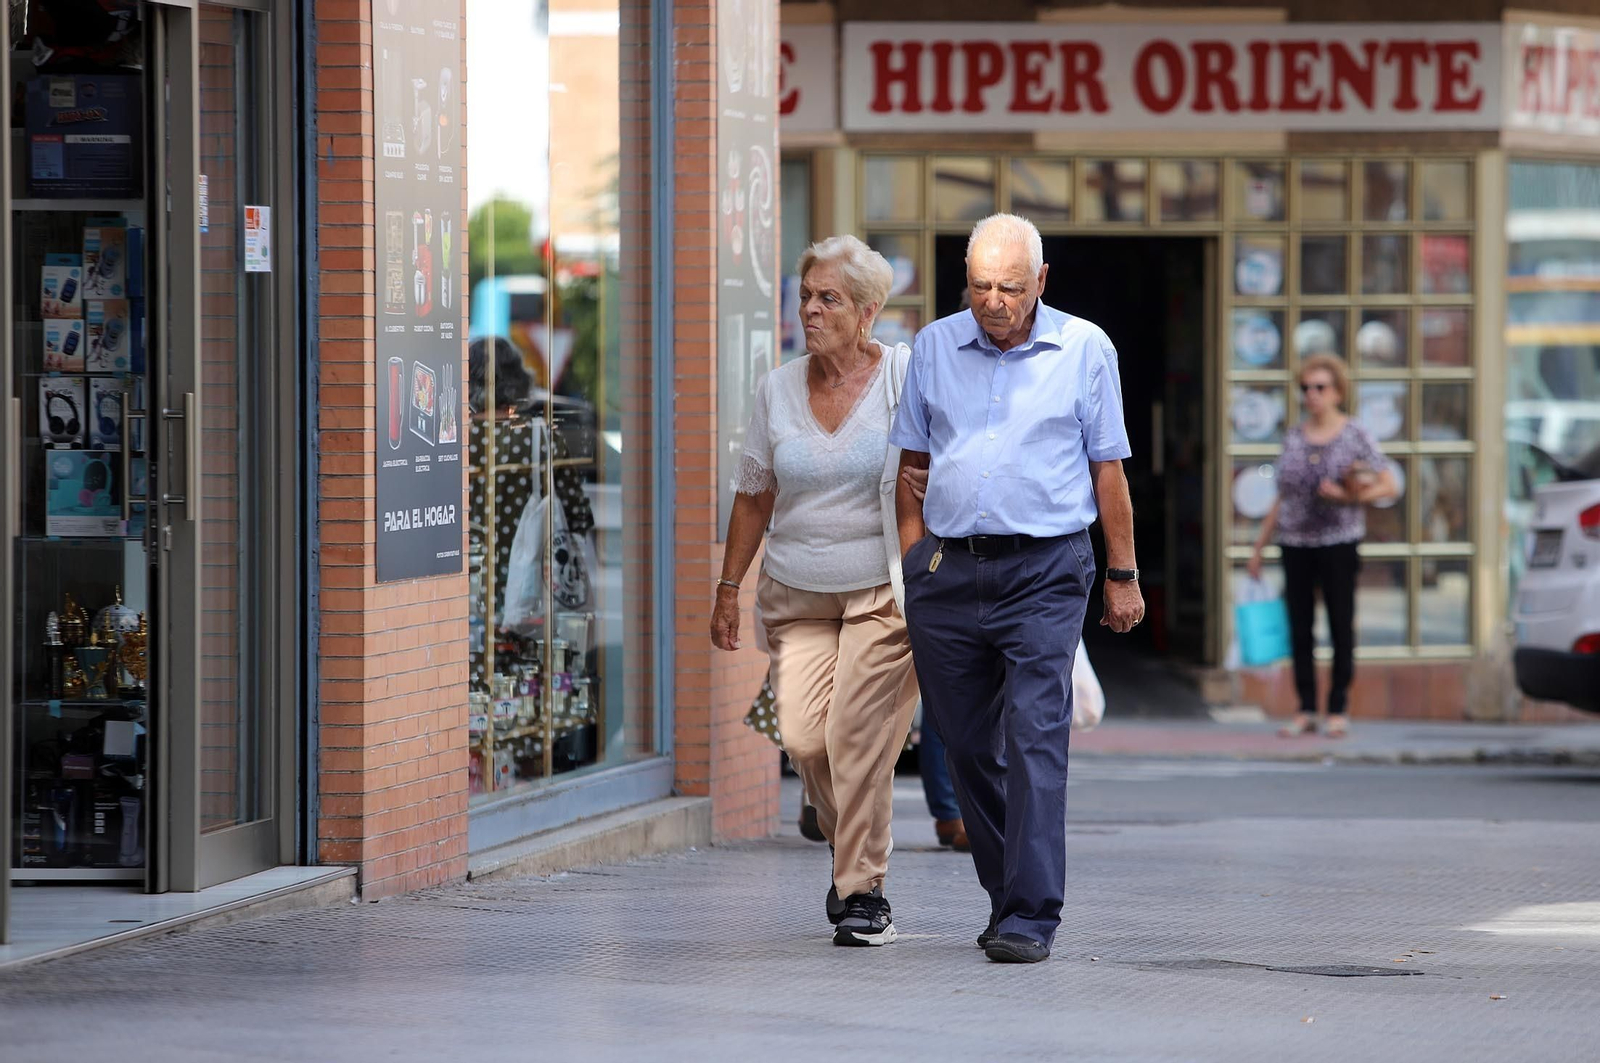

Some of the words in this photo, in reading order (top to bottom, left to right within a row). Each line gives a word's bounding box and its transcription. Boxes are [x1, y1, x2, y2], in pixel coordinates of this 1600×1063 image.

[869, 39, 1110, 114] HIPER
[1133, 38, 1485, 115] ORIENTE
[384, 510, 411, 532] PARA
[412, 508, 423, 528] EL
[424, 504, 455, 527] HOGAR
